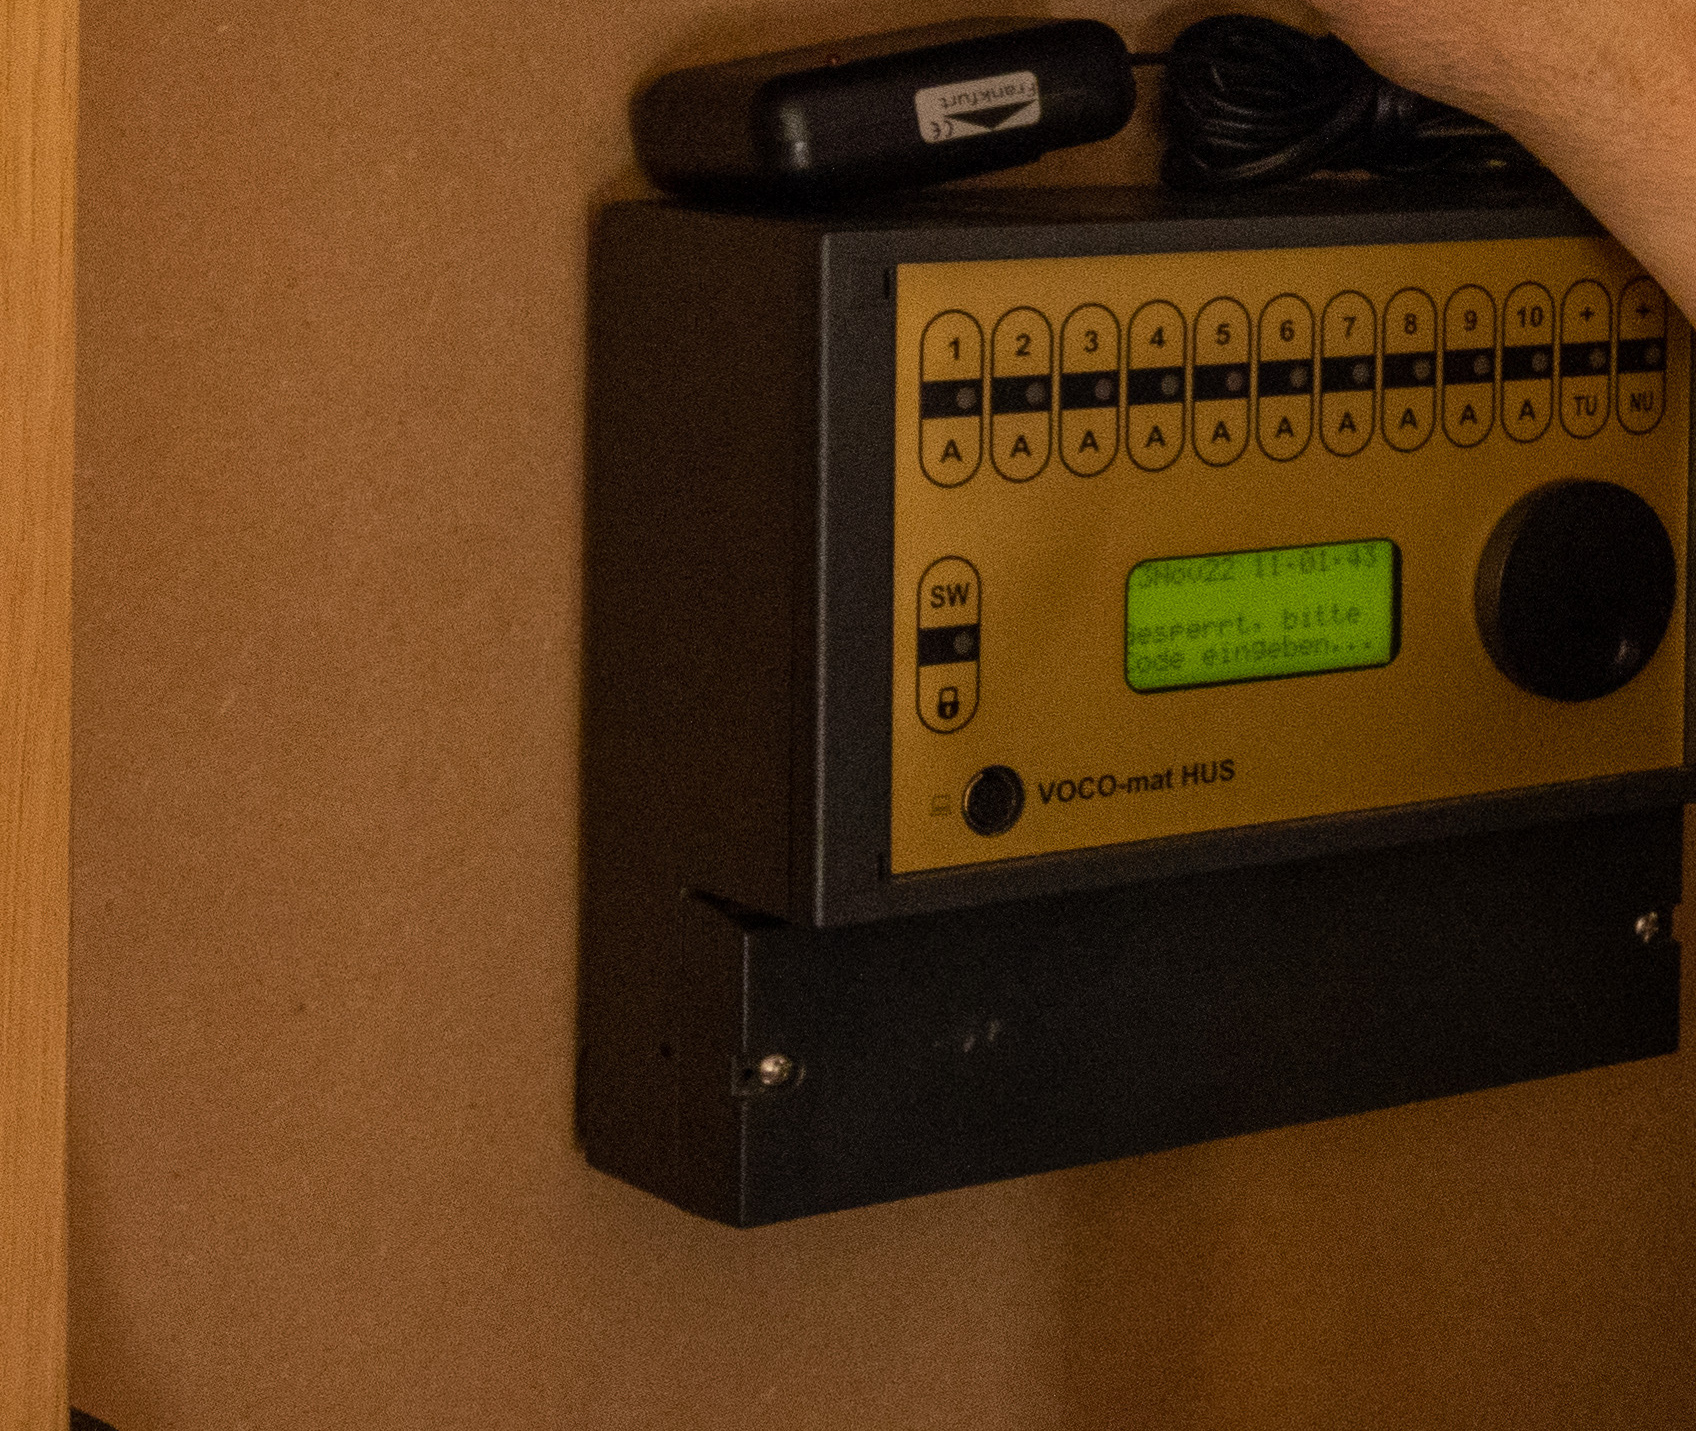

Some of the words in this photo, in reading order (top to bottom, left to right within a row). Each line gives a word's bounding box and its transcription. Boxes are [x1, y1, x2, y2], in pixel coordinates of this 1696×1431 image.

[940, 82, 1038, 110] Frankfurt
[1341, 316, 1357, 338] 7
[1404, 313, 1418, 334] 8
[1464, 310, 1478, 331] 9
[1517, 305, 1545, 328] 10
[1084, 329, 1100, 353] 3
[1149, 326, 1166, 348] 4
[1215, 323, 1231, 346] 5
[1279, 319, 1295, 343] 6
[948, 336, 961, 360] 1
[1015, 332, 1033, 356] 2
[1459, 404, 1478, 425] A
[1517, 398, 1537, 421] A
[1573, 394, 1600, 417] TU
[1629, 392, 1655, 414] NU
[1274, 416, 1295, 439] A
[1338, 412, 1358, 433] A
[1400, 407, 1420, 429] A
[1078, 430, 1100, 453] A
[1145, 425, 1167, 448] A
[1211, 421, 1232, 444] A
[939, 438, 963, 463] A
[1010, 435, 1033, 458] A
[930, 582, 970, 610] SW
[1283, 604, 1362, 631] bitte
[1038, 769, 1173, 805] VOCO-mat
[1181, 759, 1236, 786] HUS
